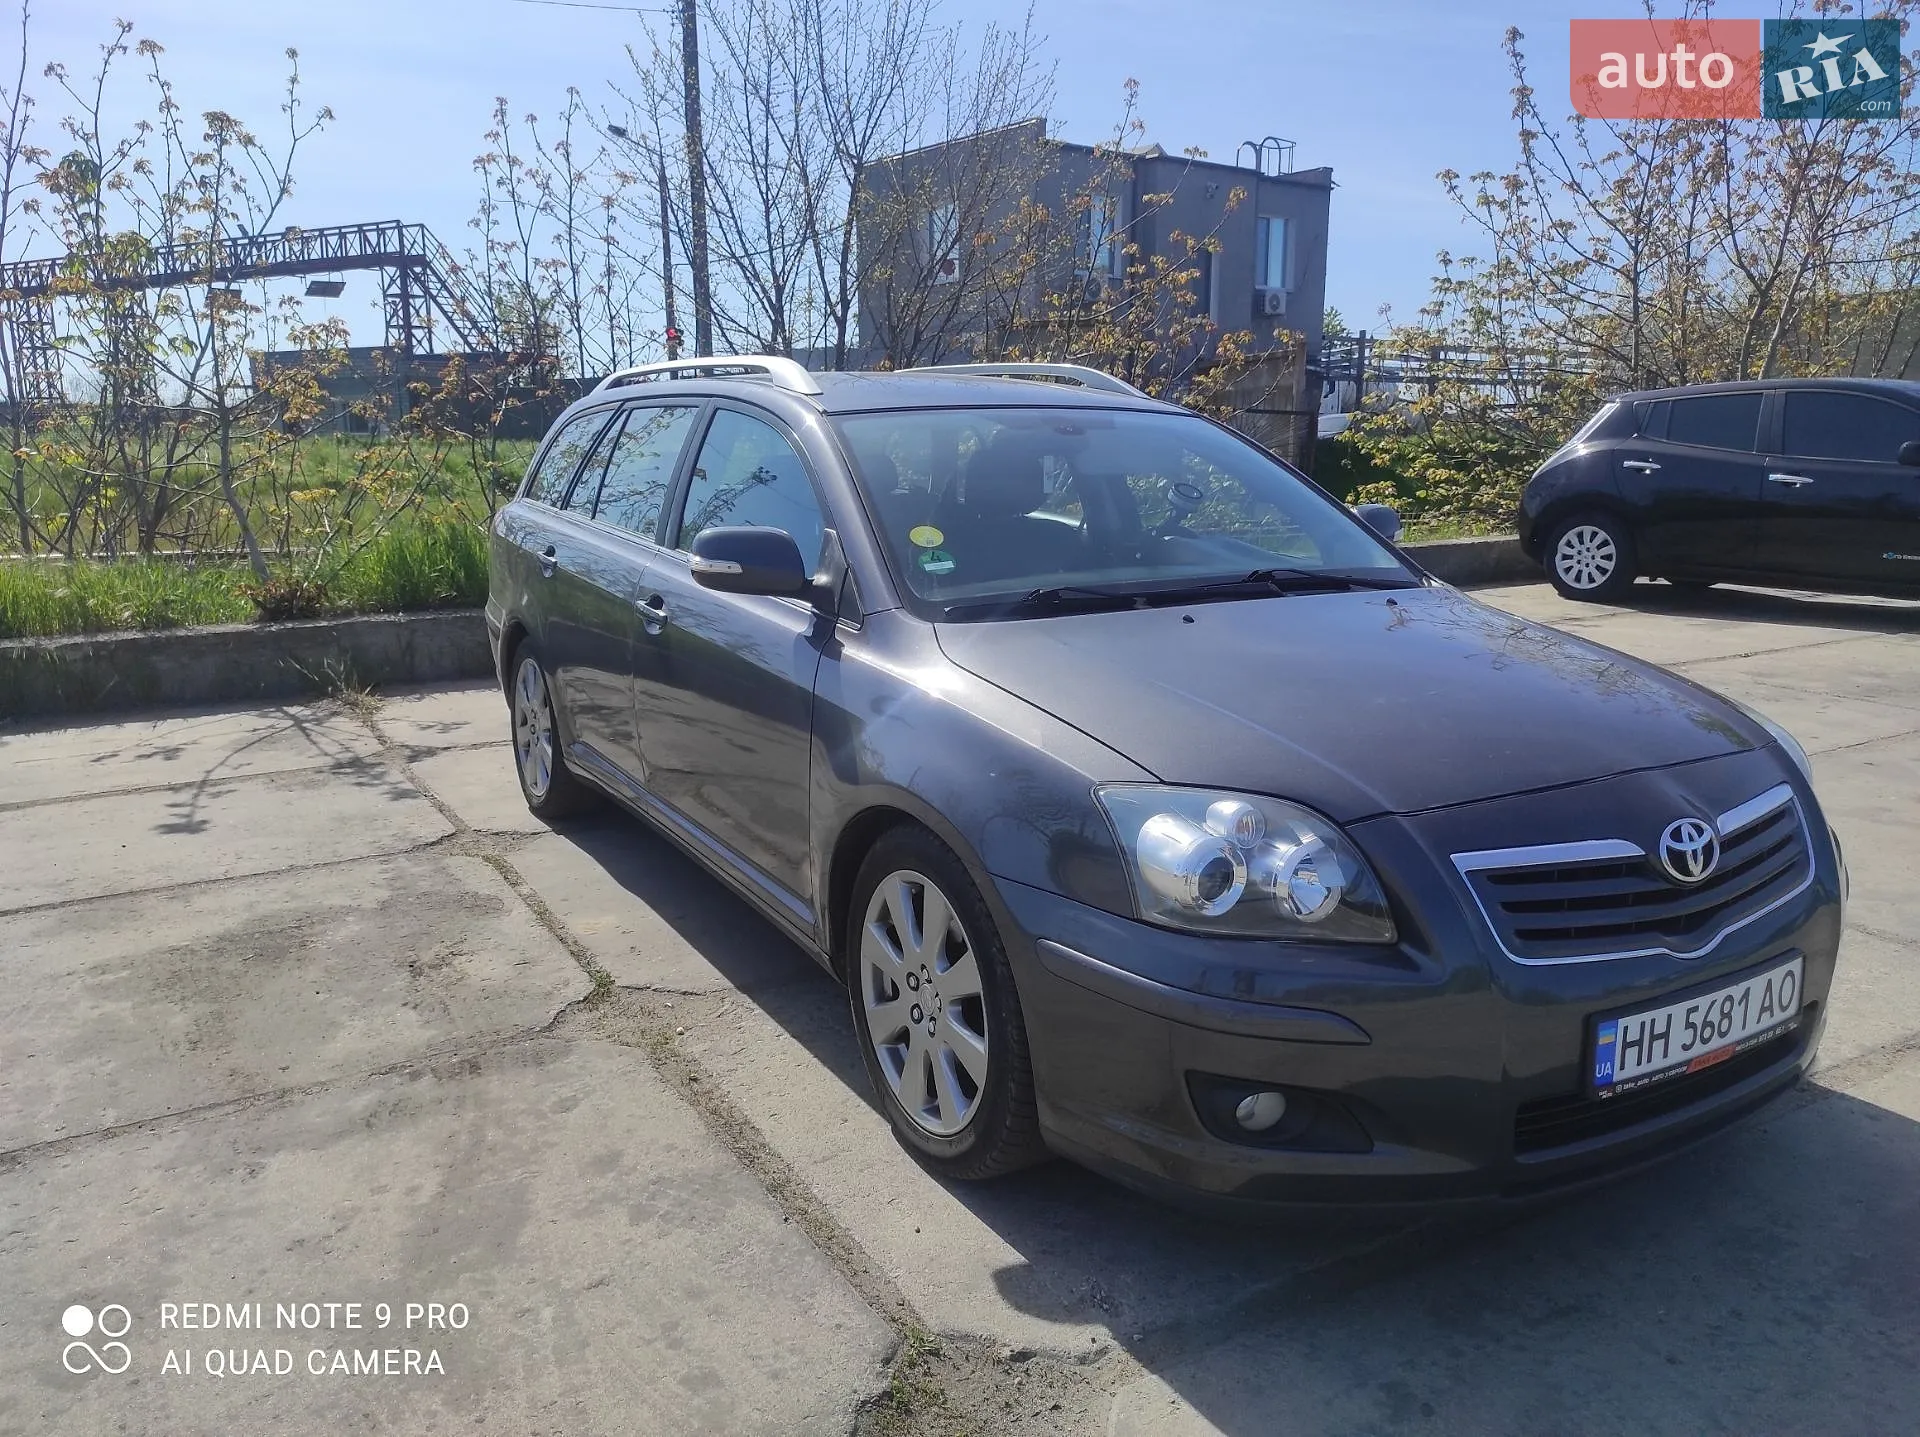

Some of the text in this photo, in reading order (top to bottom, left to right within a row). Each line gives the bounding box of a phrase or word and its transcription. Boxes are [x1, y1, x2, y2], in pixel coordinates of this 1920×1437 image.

[1619, 1013, 1673, 1071] HH
[1681, 987, 1751, 1051] 5681
[1756, 969, 1796, 1024] AO
[1595, 1061, 1612, 1078] UA
